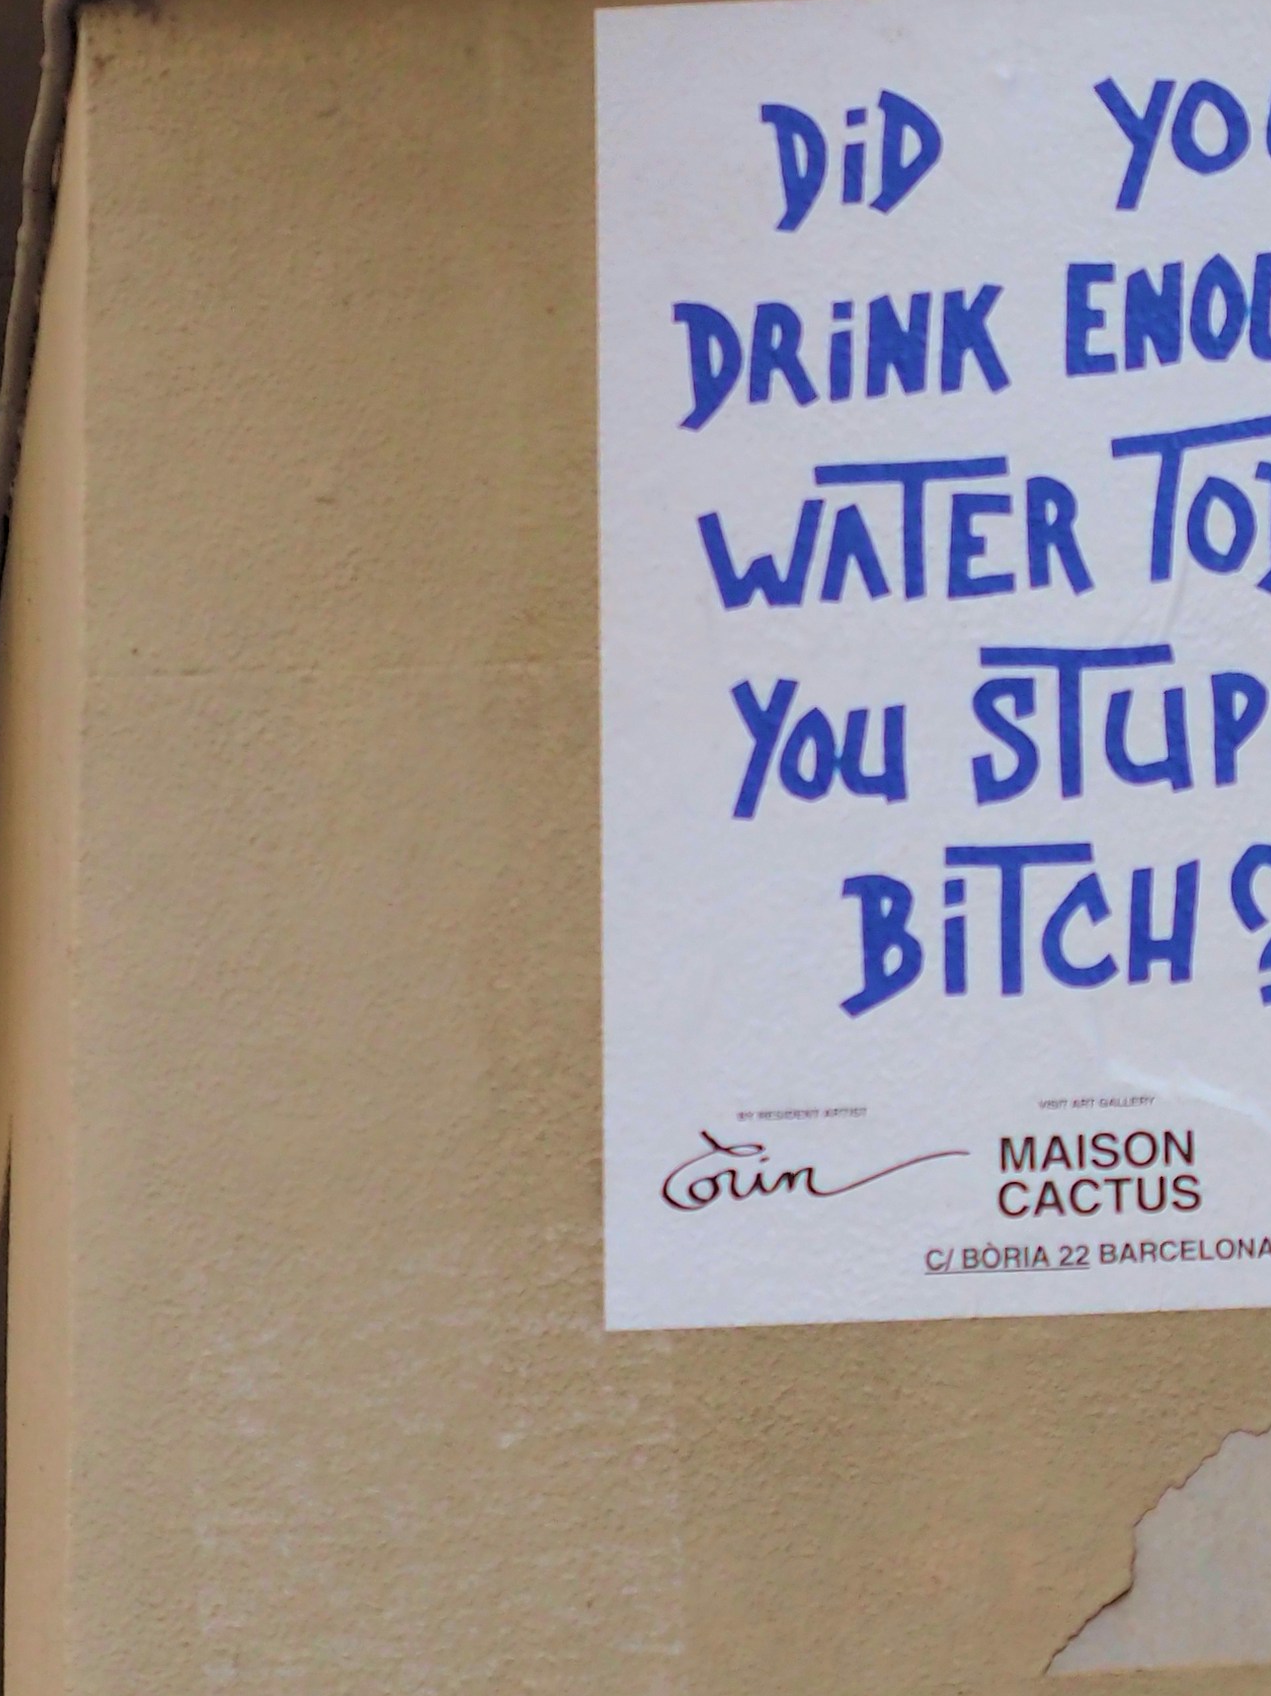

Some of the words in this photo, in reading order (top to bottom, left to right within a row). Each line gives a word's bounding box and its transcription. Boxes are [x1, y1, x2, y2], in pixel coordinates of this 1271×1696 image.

[698, 455, 1093, 610] WATER
[999, 1128, 1194, 1174] MAISON
[996, 1173, 1203, 1219] CACTUS
[925, 1248, 954, 1272] C/
[1059, 1245, 1090, 1267] 22
